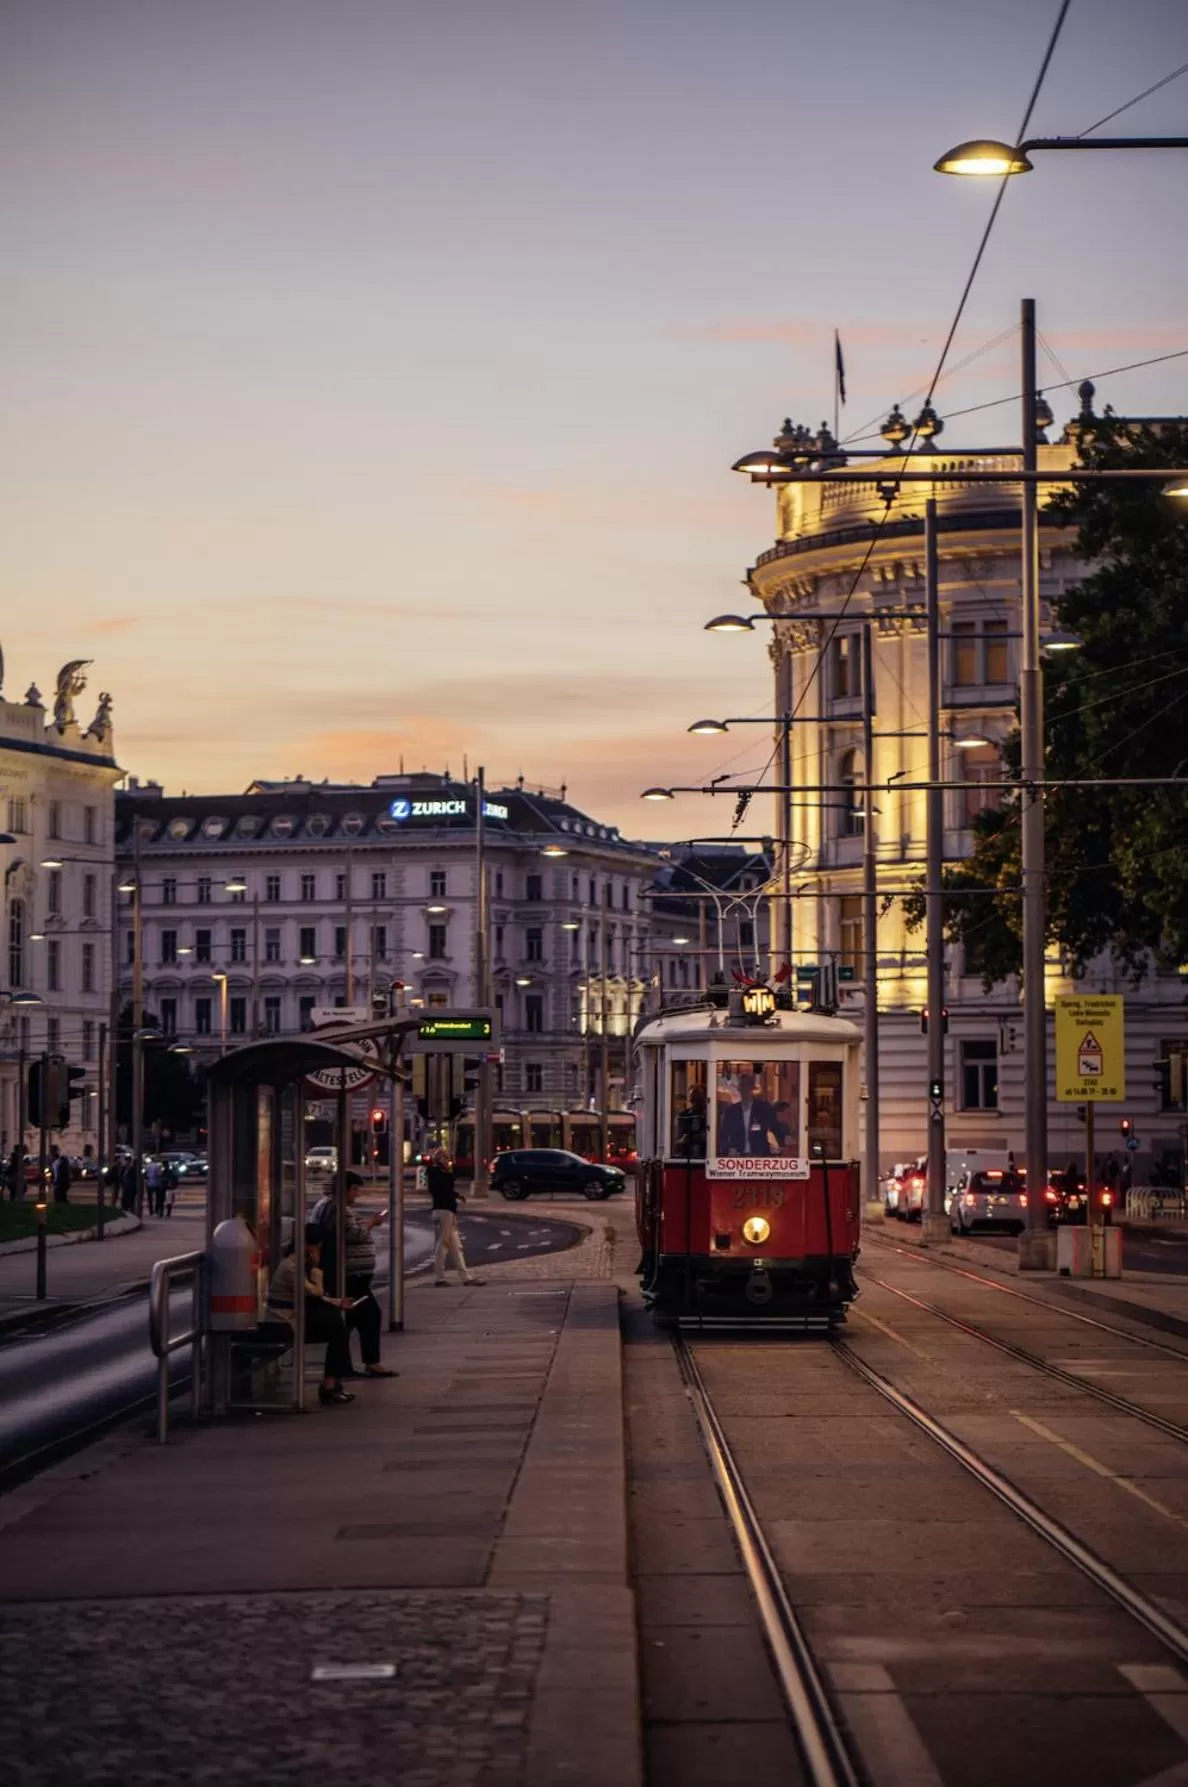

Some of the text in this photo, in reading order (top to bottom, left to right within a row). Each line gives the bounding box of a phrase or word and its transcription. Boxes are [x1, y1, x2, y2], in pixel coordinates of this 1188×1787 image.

[411, 800, 466, 815] ZURICH
[743, 988, 776, 1015] WTM
[718, 1159, 798, 1170] SONDERZUG
[739, 1170, 807, 1178] Tramwaymuseum
